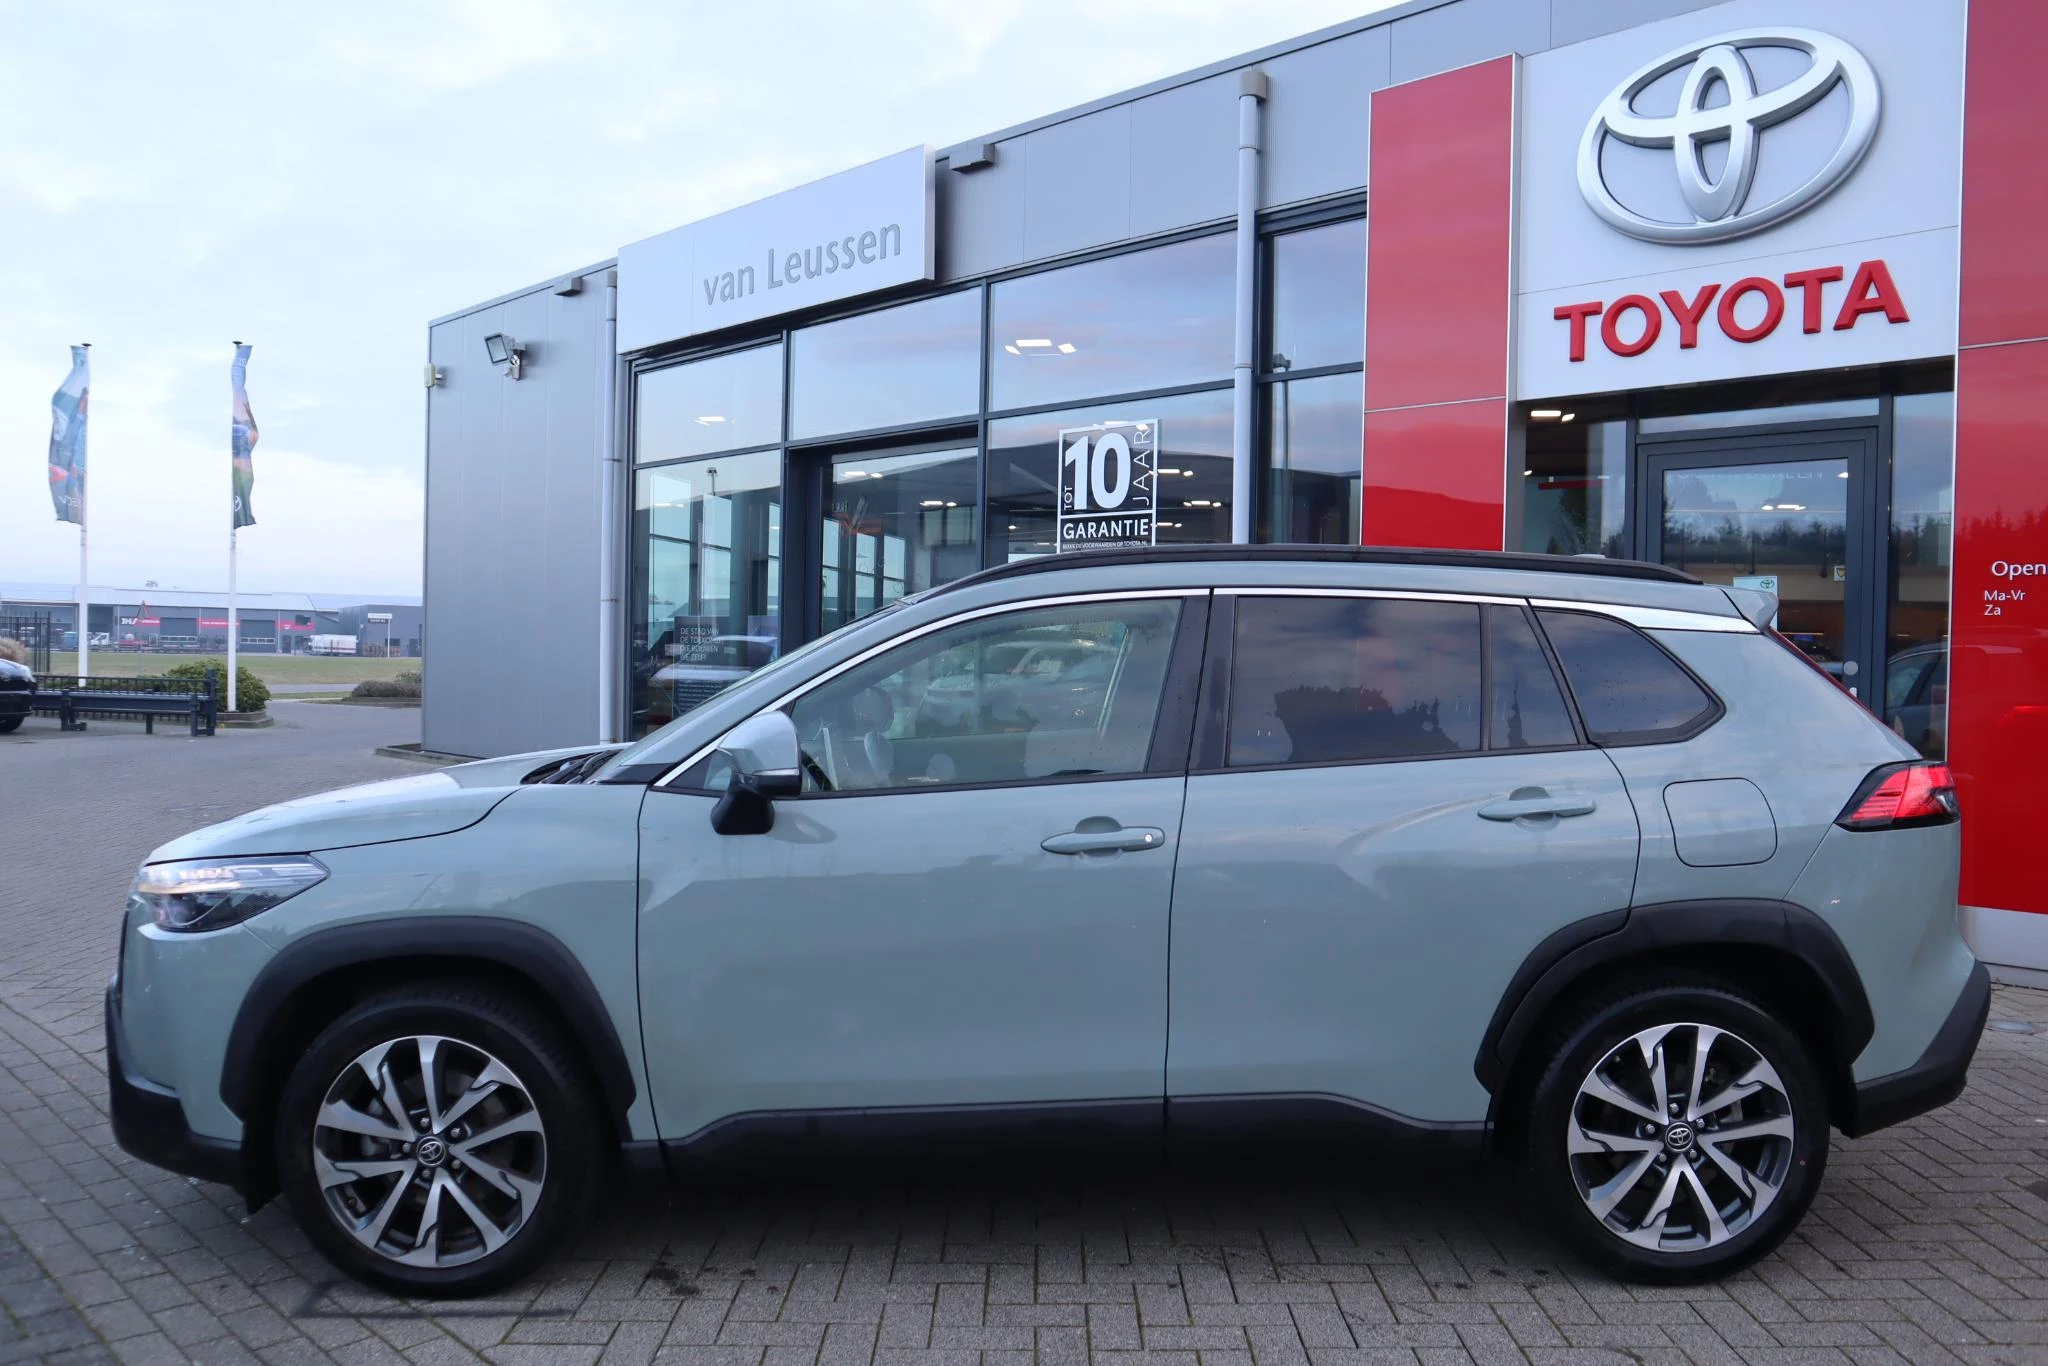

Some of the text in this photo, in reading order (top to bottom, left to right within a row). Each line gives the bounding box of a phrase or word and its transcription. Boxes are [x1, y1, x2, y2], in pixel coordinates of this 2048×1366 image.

[703, 223, 901, 306] van Leussen
[1554, 259, 1911, 363] TOYOTA
[1064, 432, 1131, 510] 10
[1132, 428, 1151, 506] JAAR
[1063, 486, 1073, 511] TOT
[1063, 518, 1149, 540] GARANTIE
[1984, 589, 2026, 601] Ma-Vr
[1984, 604, 2001, 616] Za
